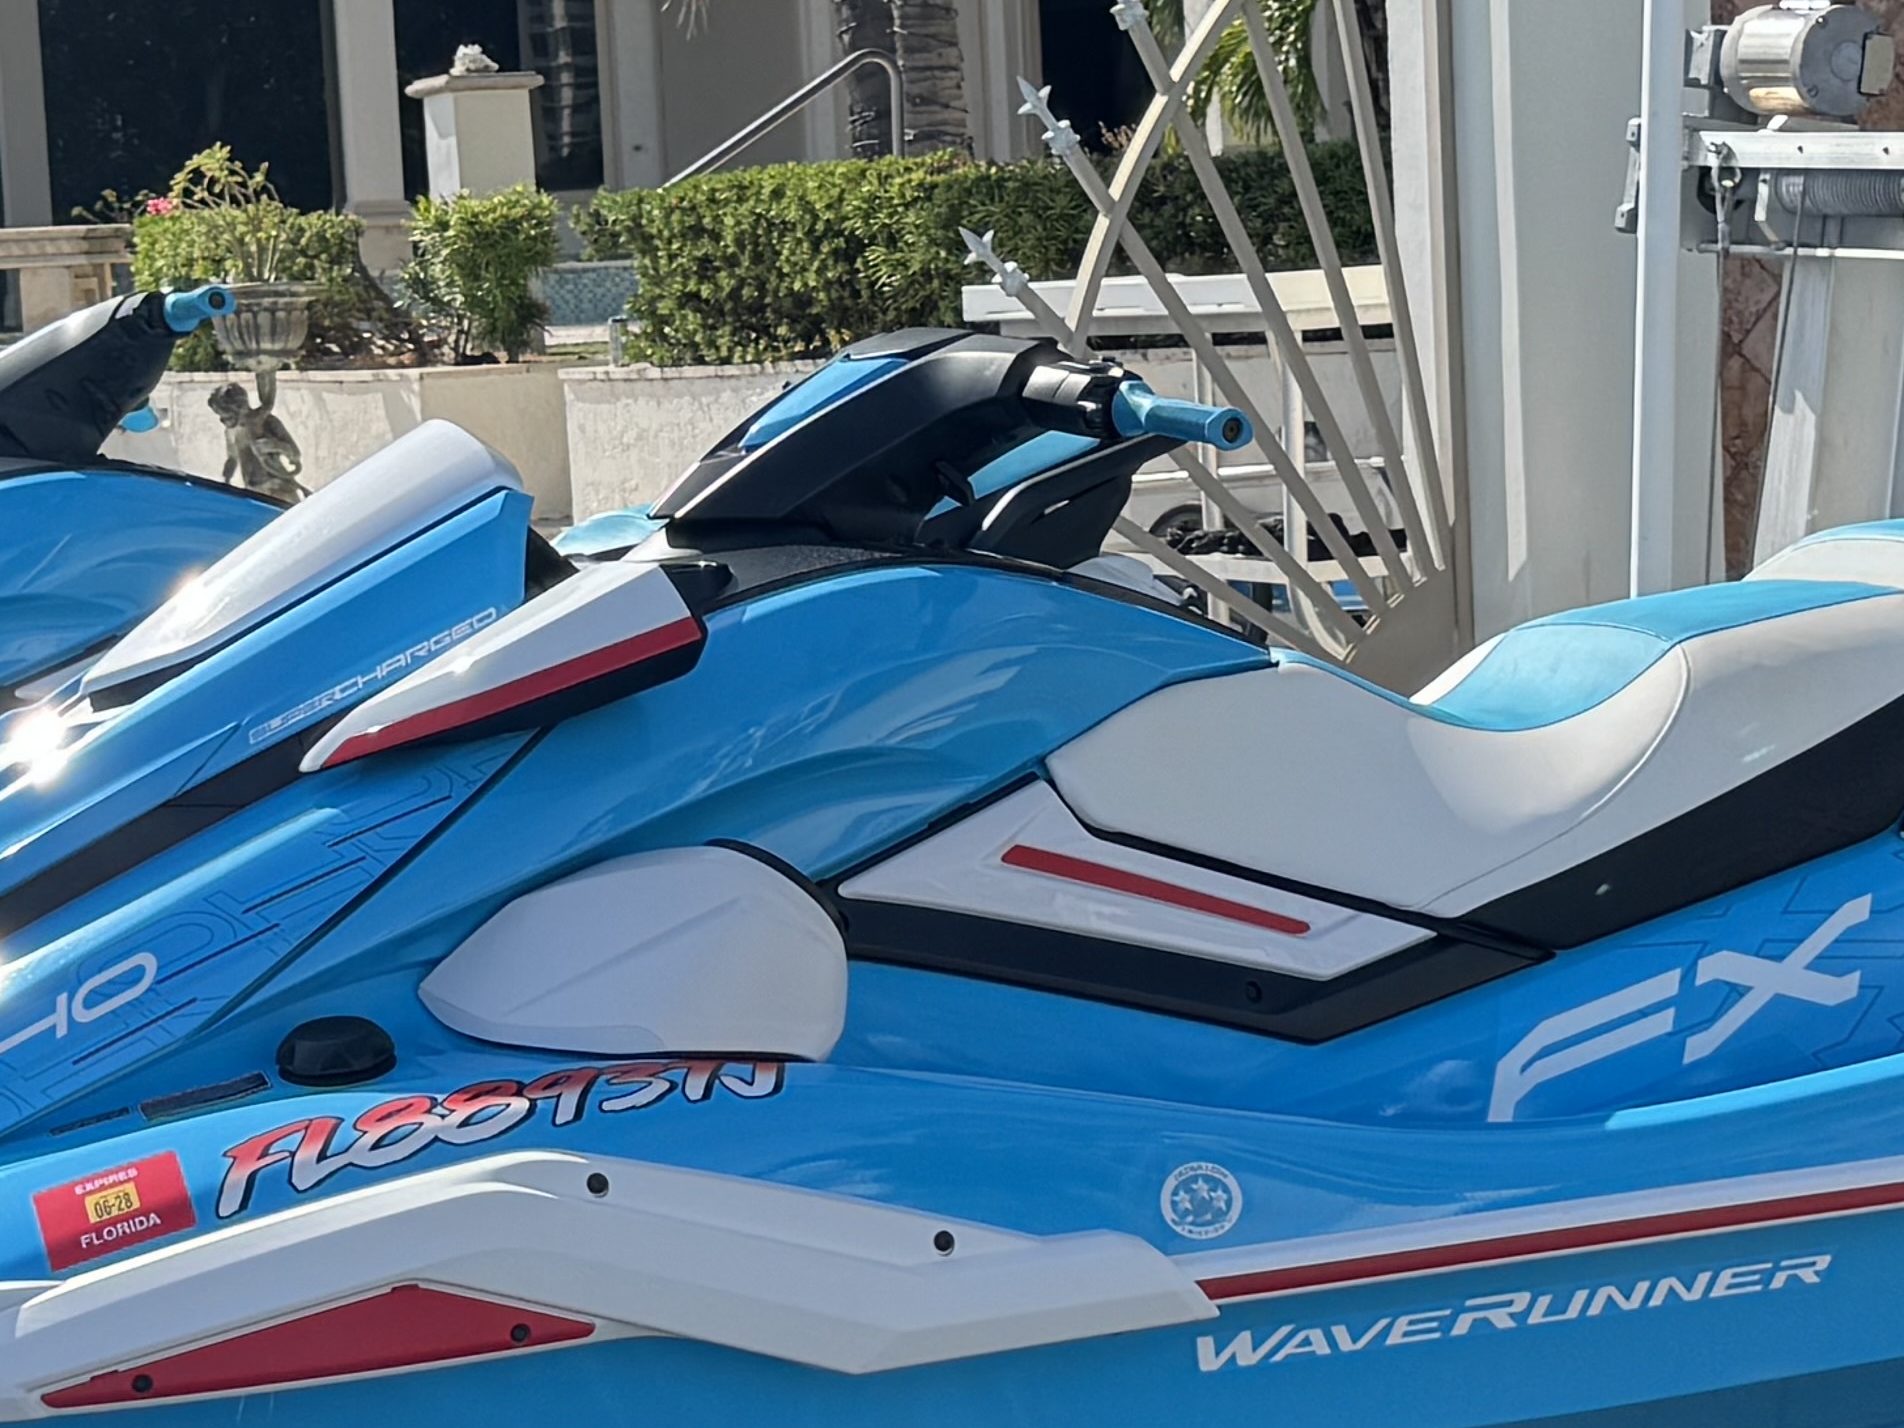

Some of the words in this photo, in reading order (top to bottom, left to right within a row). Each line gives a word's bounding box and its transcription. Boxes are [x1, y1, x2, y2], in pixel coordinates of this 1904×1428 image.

[1487, 893, 1872, 1122] FX
[75, 1167, 138, 1195] EXPIRES
[93, 1192, 134, 1220] 06-28
[80, 1212, 162, 1249] FLORIDA
